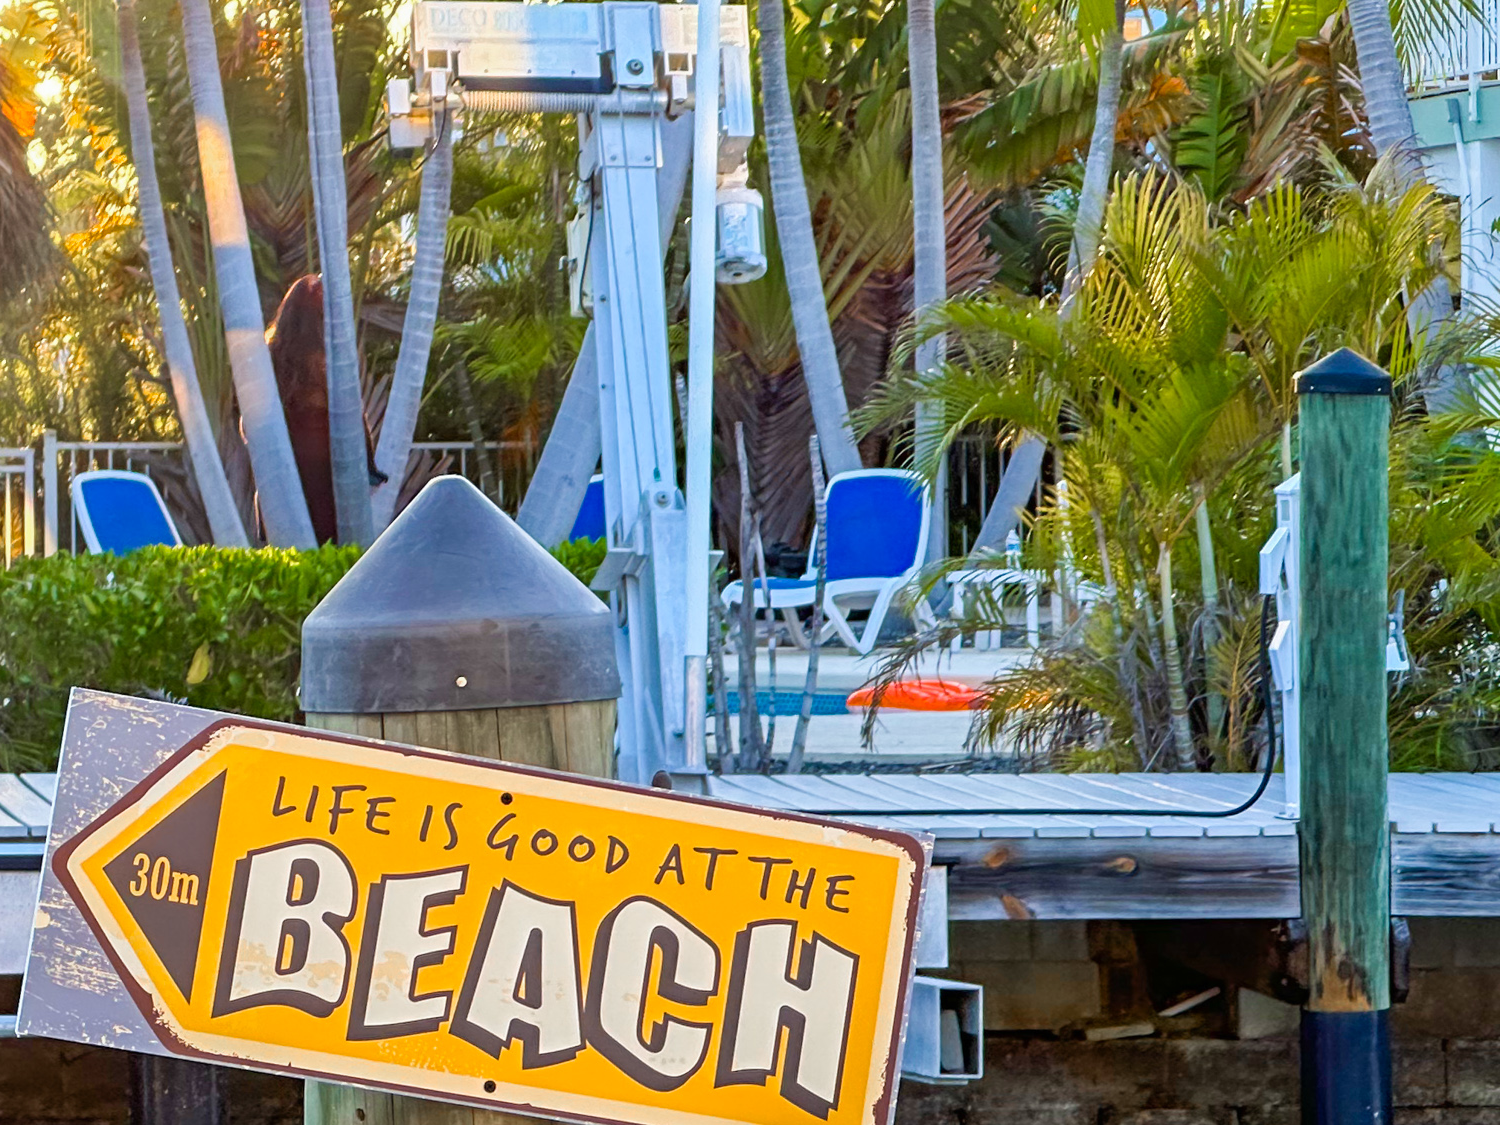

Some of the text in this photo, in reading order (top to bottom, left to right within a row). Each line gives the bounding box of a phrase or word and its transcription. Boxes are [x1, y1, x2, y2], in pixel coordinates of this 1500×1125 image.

[129, 852, 200, 906] 30m
[273, 776, 855, 914] LIFE IS GOOD AT THE
[212, 838, 861, 1121] BEACH
